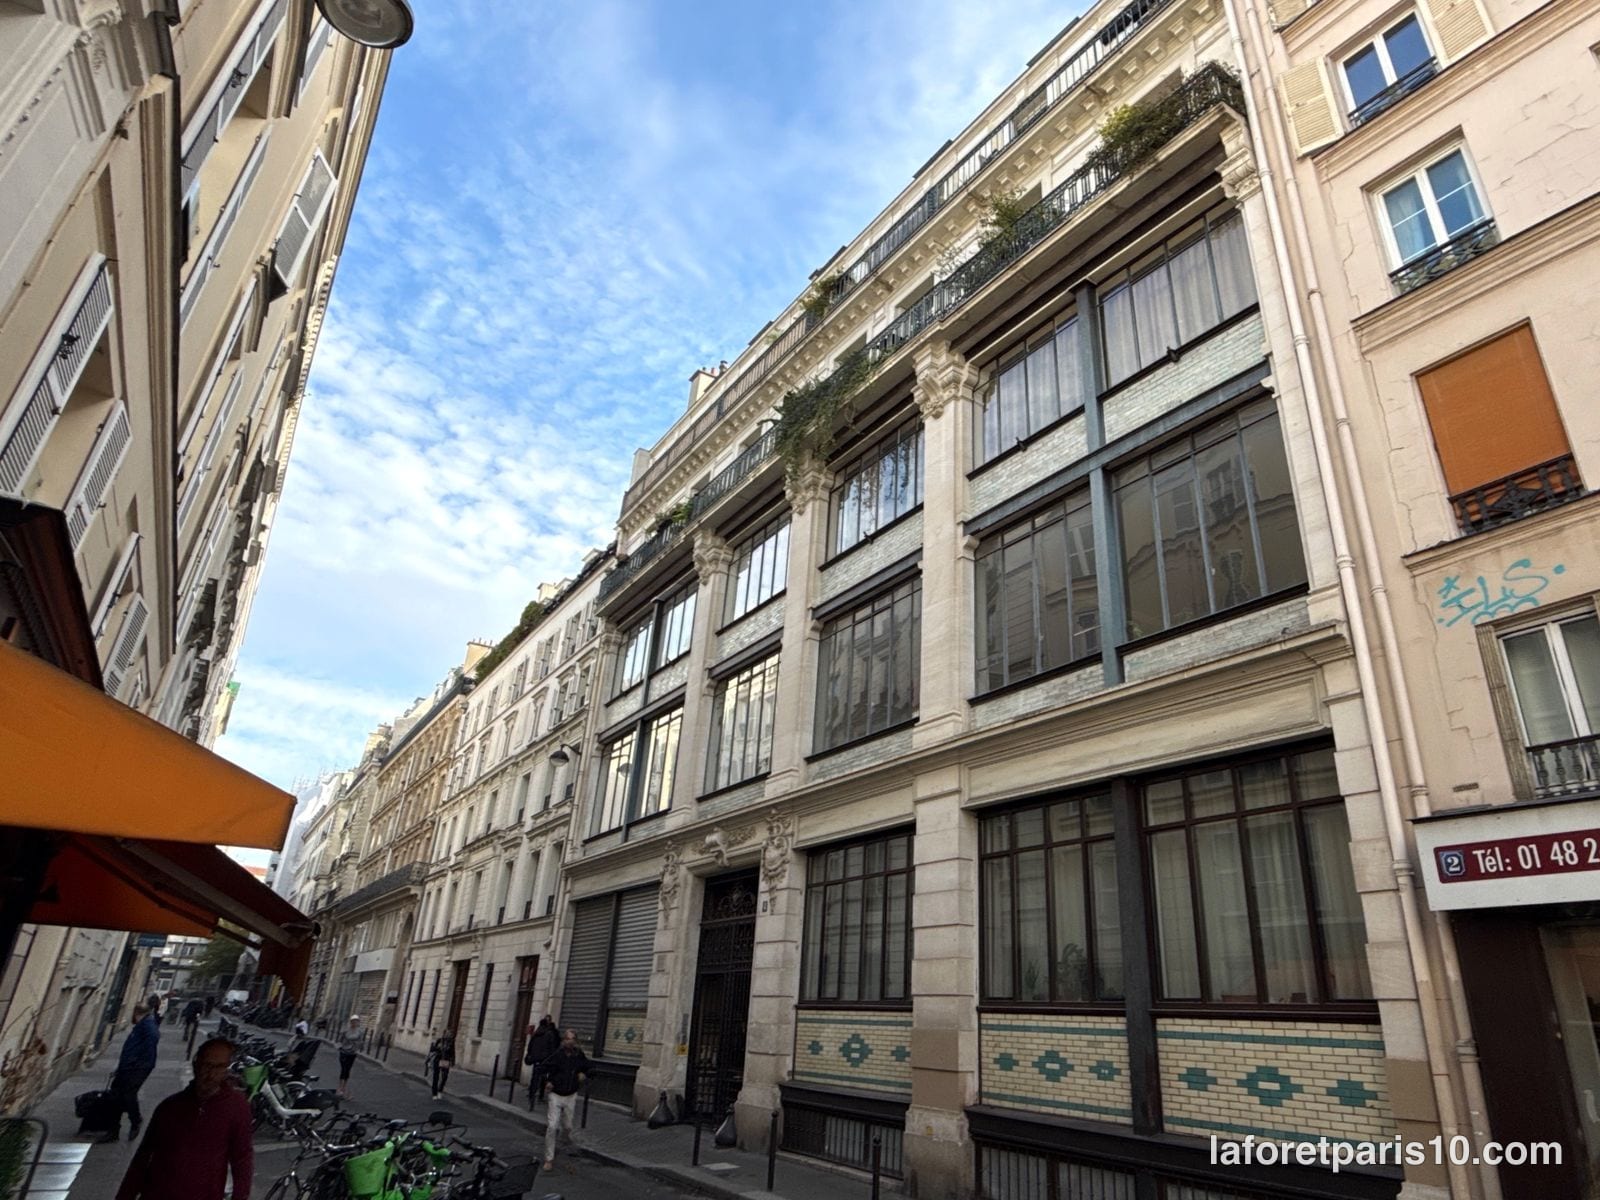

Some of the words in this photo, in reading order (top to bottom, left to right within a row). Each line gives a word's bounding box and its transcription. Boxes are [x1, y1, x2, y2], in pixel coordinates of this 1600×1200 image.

[1447, 856, 1461, 872] 2
[1472, 847, 1512, 873] Tél:
[1517, 844, 1541, 870] 01
[1550, 840, 1579, 866] 48
